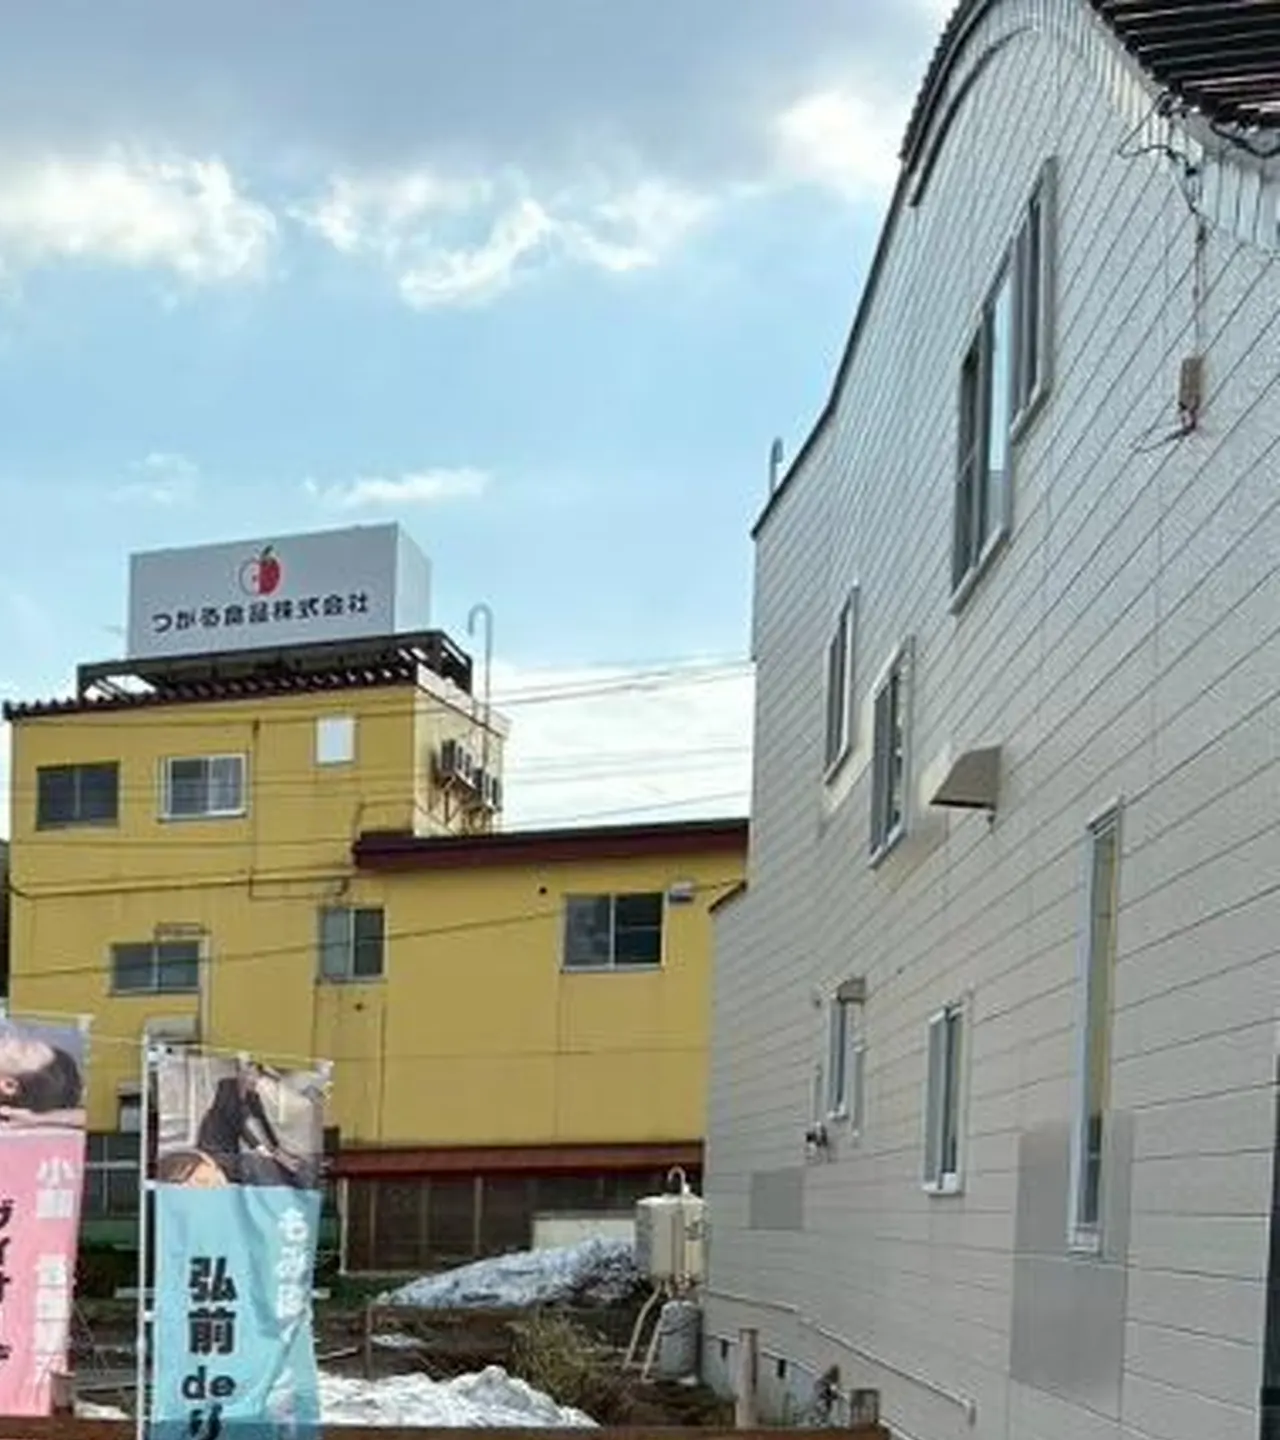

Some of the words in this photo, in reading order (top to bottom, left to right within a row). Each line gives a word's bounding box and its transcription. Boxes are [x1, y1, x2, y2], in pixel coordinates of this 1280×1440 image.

[152, 592, 369, 634] つがる食品株式会社
